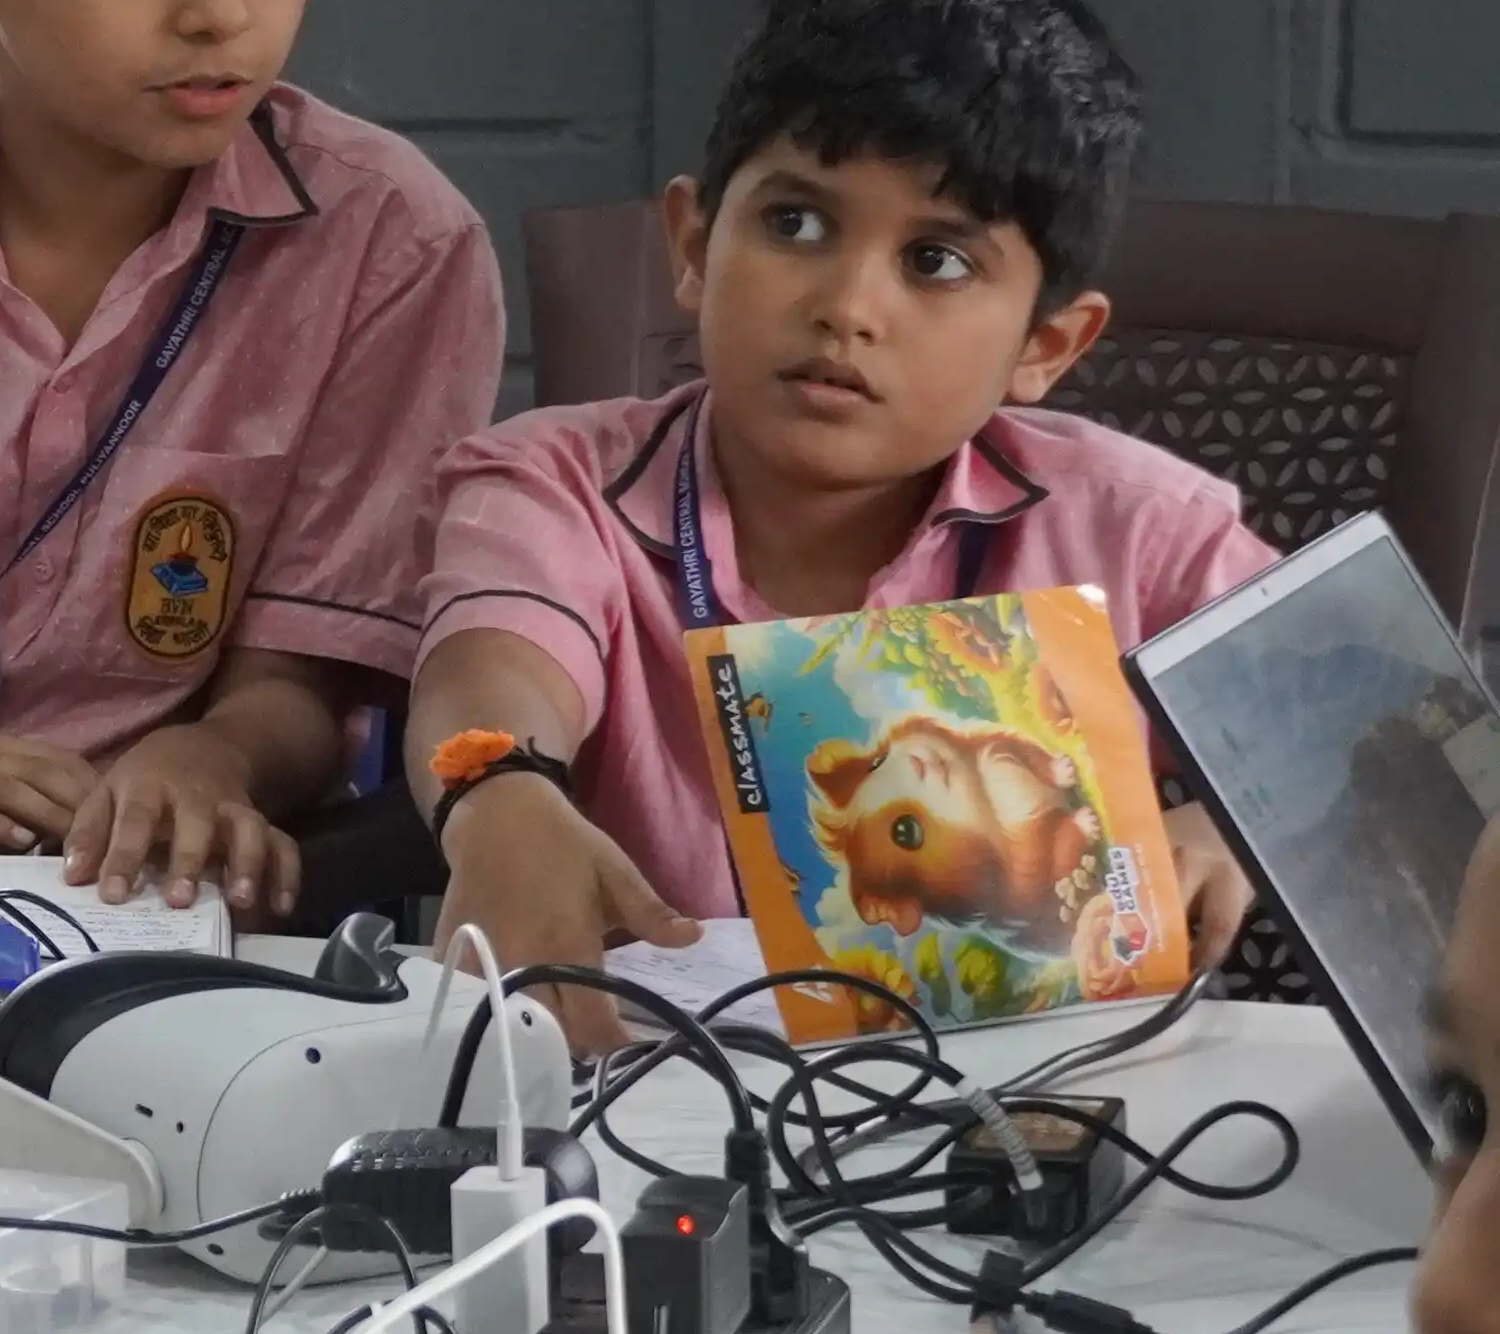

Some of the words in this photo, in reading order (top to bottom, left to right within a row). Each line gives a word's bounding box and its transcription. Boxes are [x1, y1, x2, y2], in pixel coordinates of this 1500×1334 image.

[155, 305, 199, 371] GAYATHRI
[189, 246, 228, 308] CENTRAL
[80, 398, 143, 487] PULIYANNOOR
[681, 548, 709, 619] GAYATHRI
[1112, 850, 1136, 912] GAMES
